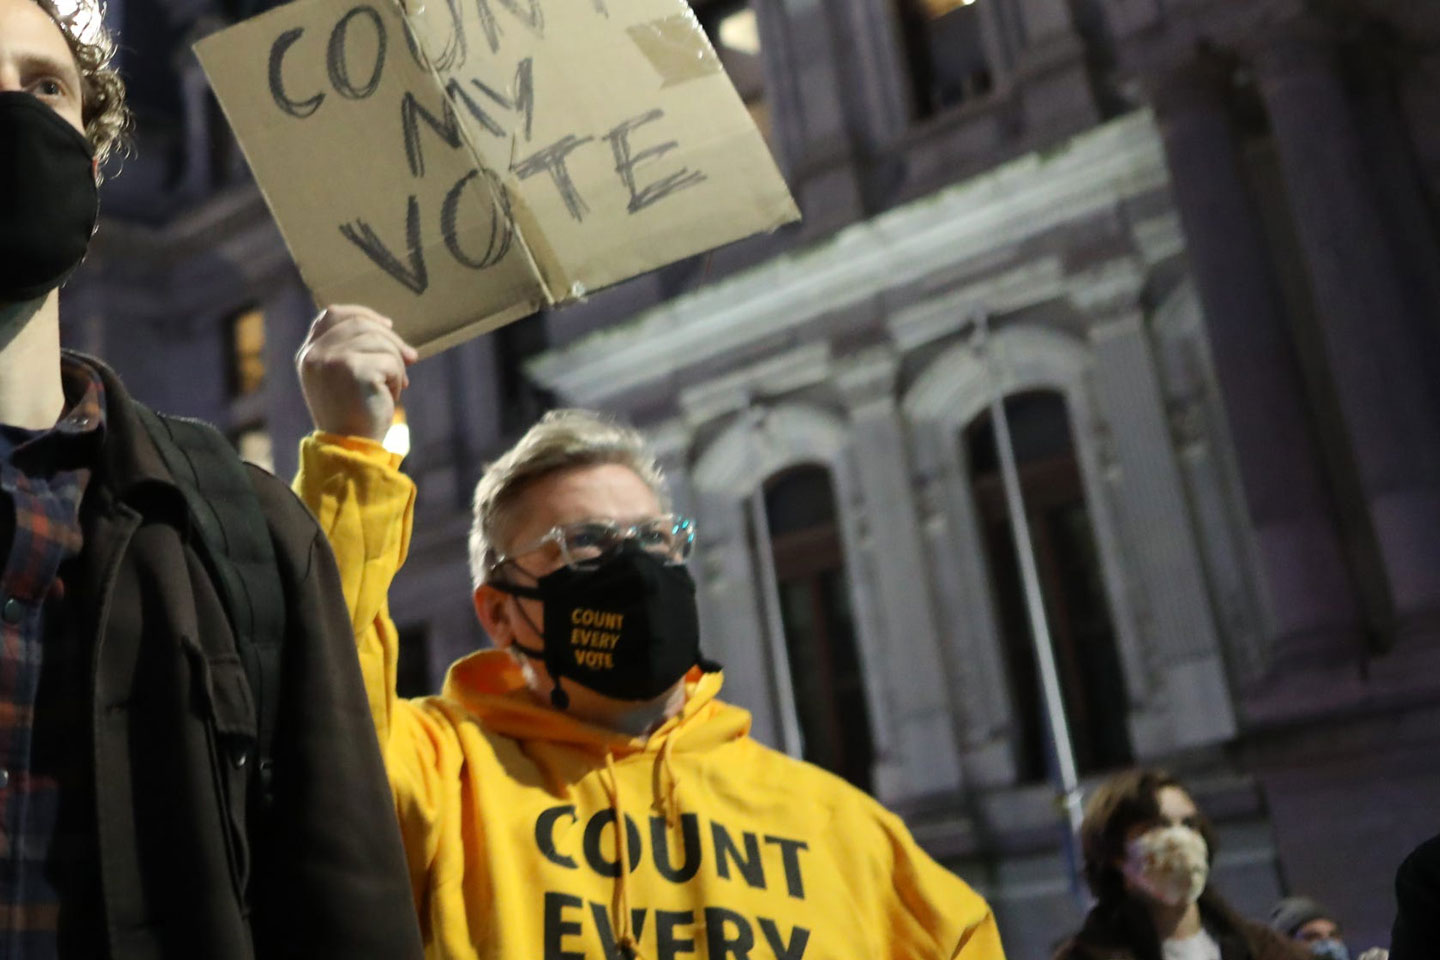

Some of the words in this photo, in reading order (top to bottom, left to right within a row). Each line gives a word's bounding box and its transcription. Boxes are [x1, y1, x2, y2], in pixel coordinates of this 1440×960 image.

[401, 57, 534, 177] MY
[340, 109, 707, 296] VOTE
[570, 628, 620, 649] EVERY
[571, 608, 624, 630] COUNT
[574, 649, 613, 669] VOTE
[534, 804, 809, 900] COUNT
[543, 891, 811, 959] EVERY
